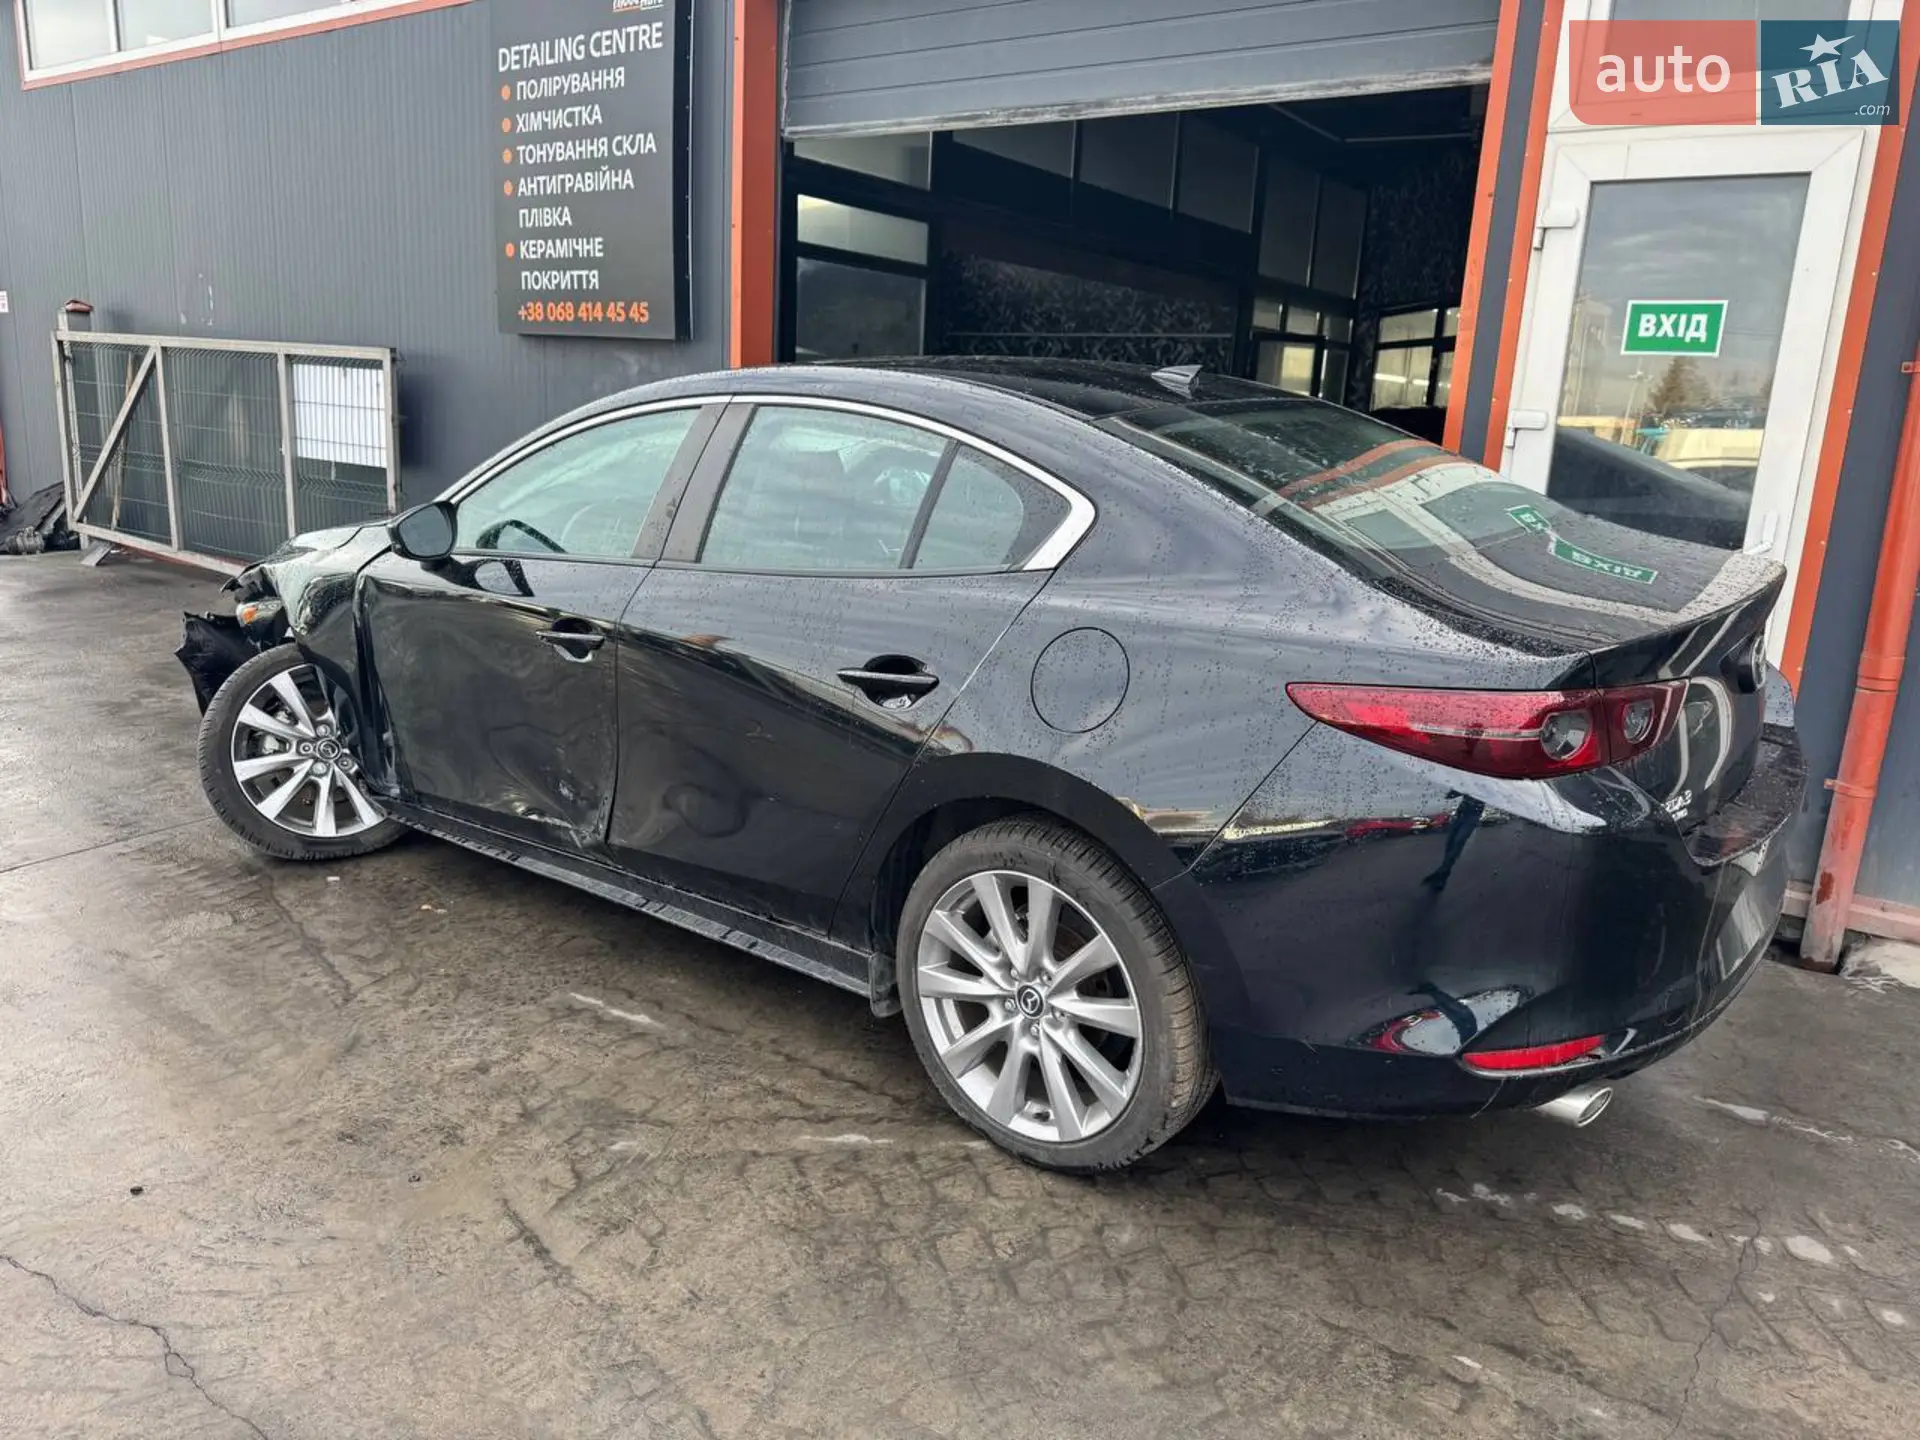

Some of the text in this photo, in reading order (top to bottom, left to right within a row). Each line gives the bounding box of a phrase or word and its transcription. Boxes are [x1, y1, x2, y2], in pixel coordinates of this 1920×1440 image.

[498, 22, 664, 73] DETAILING CENTRE
[516, 66, 625, 101] ПОЛІРУВАННЯ
[516, 104, 603, 133] ХІМЧИСТКА
[517, 132, 657, 165] ТОНУВАННЯ СКЛА
[518, 166, 634, 197] АНТИГРАВІЙНА
[519, 206, 572, 228] ПЛІВКА
[520, 237, 604, 259] КЕРАМІЧНЕ
[521, 269, 600, 290] ПОКРИТТЯ
[518, 302, 649, 323] +38 068 414 45 45
[1638, 313, 1708, 343] ВХІД
